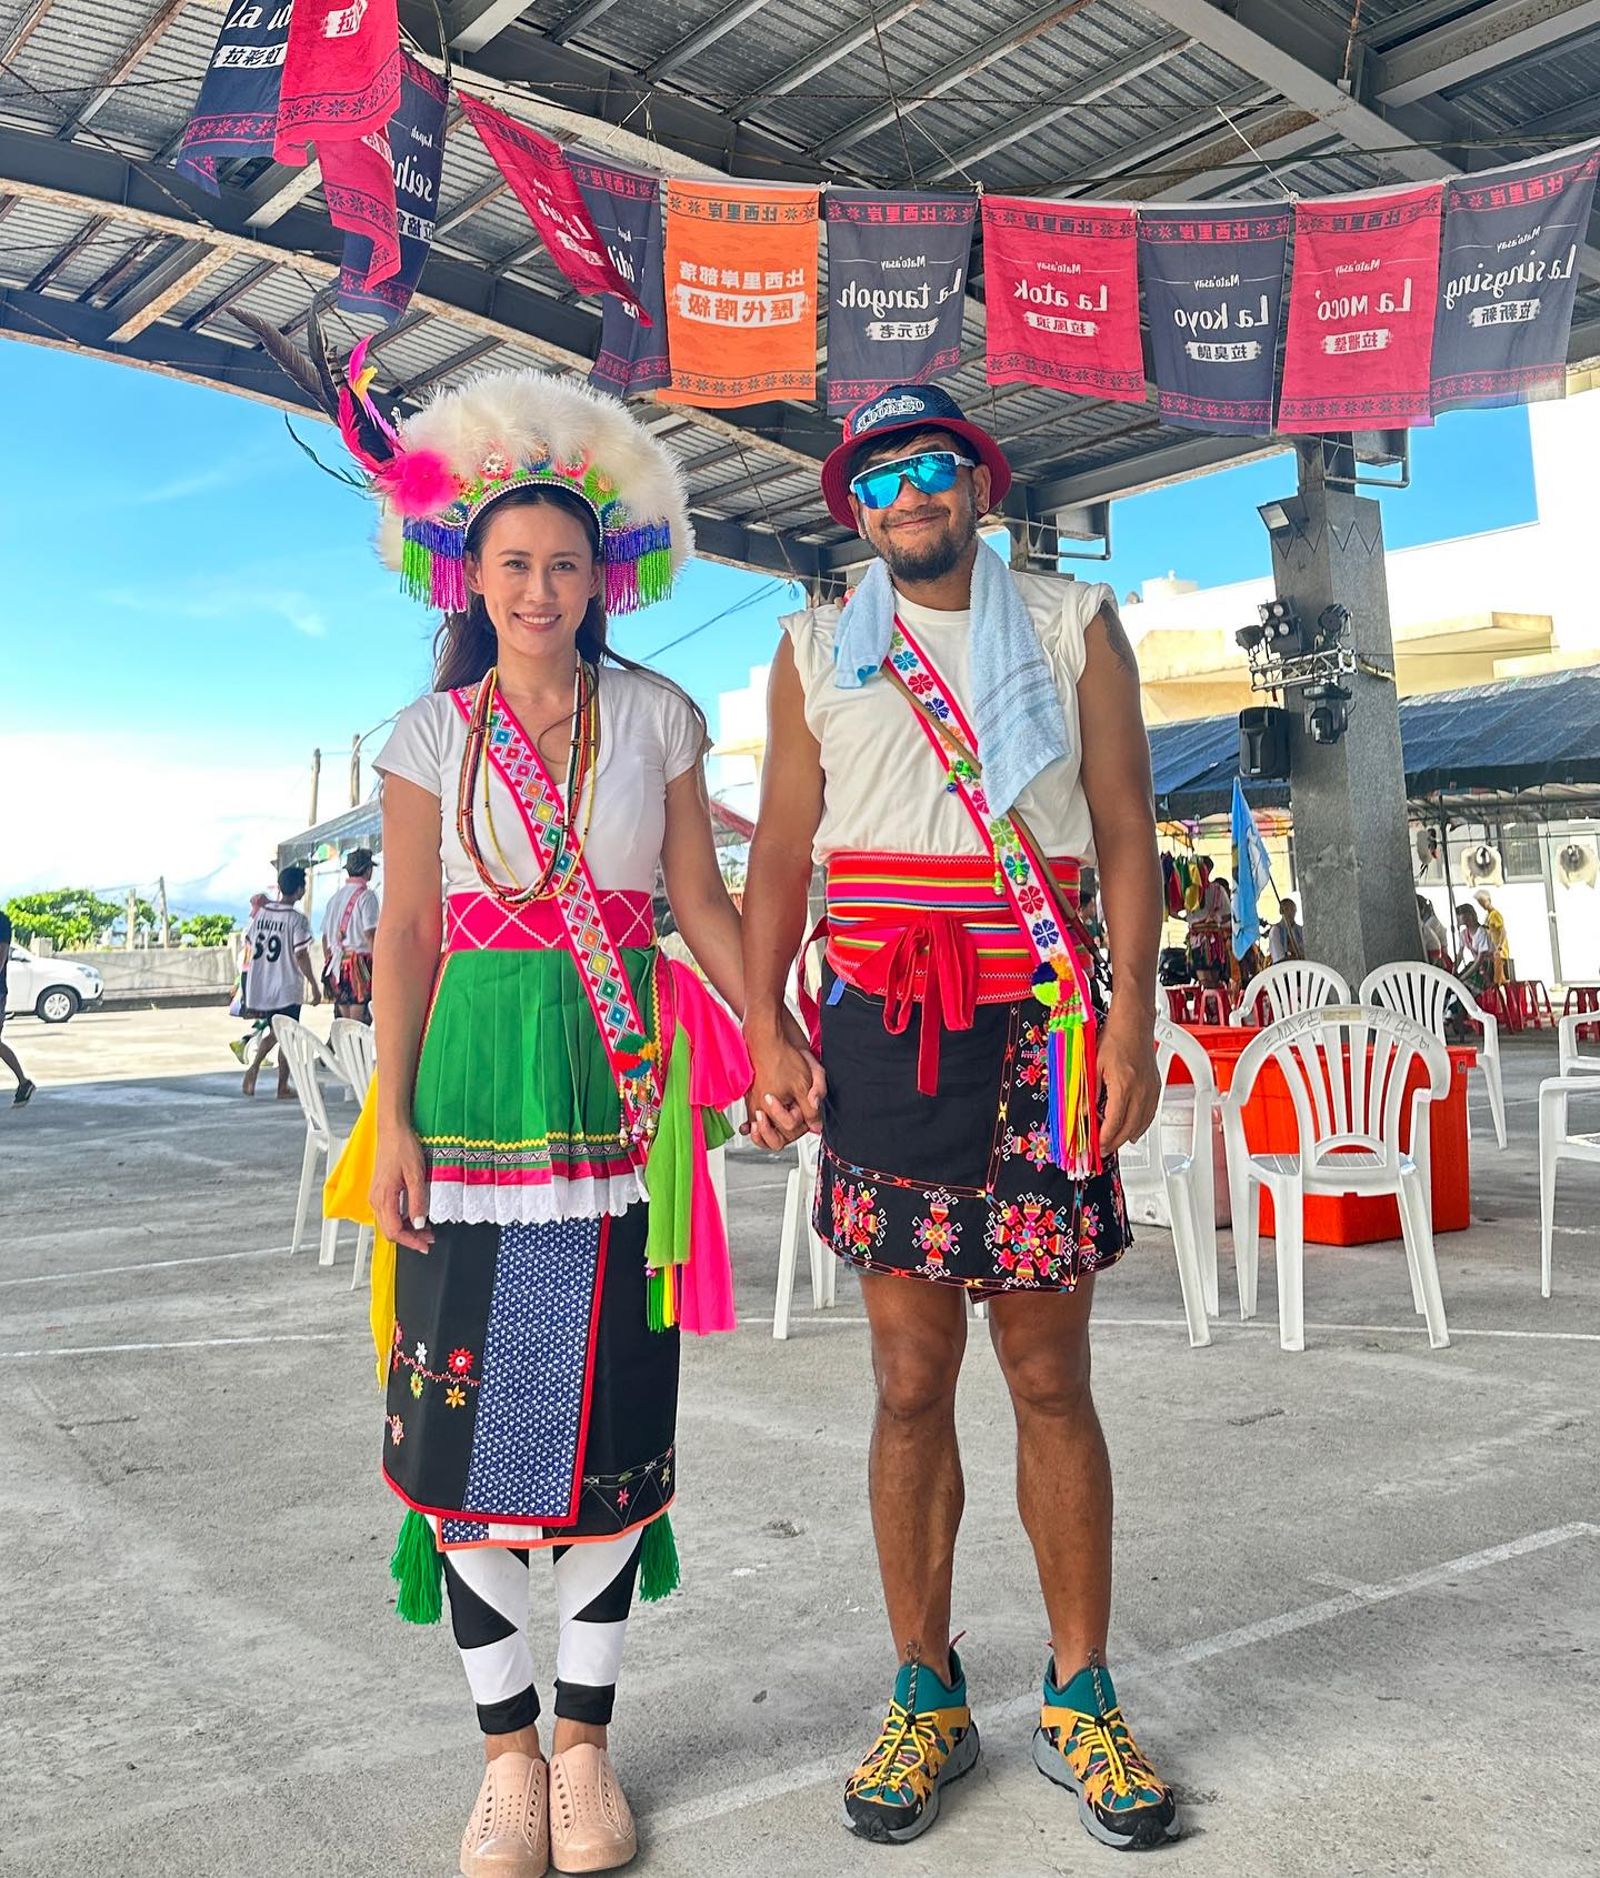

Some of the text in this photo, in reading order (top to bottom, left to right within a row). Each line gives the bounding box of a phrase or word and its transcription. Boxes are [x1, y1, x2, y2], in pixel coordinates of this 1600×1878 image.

[224, 0, 262, 30] La
[222, 46, 284, 66] 拉彩虹
